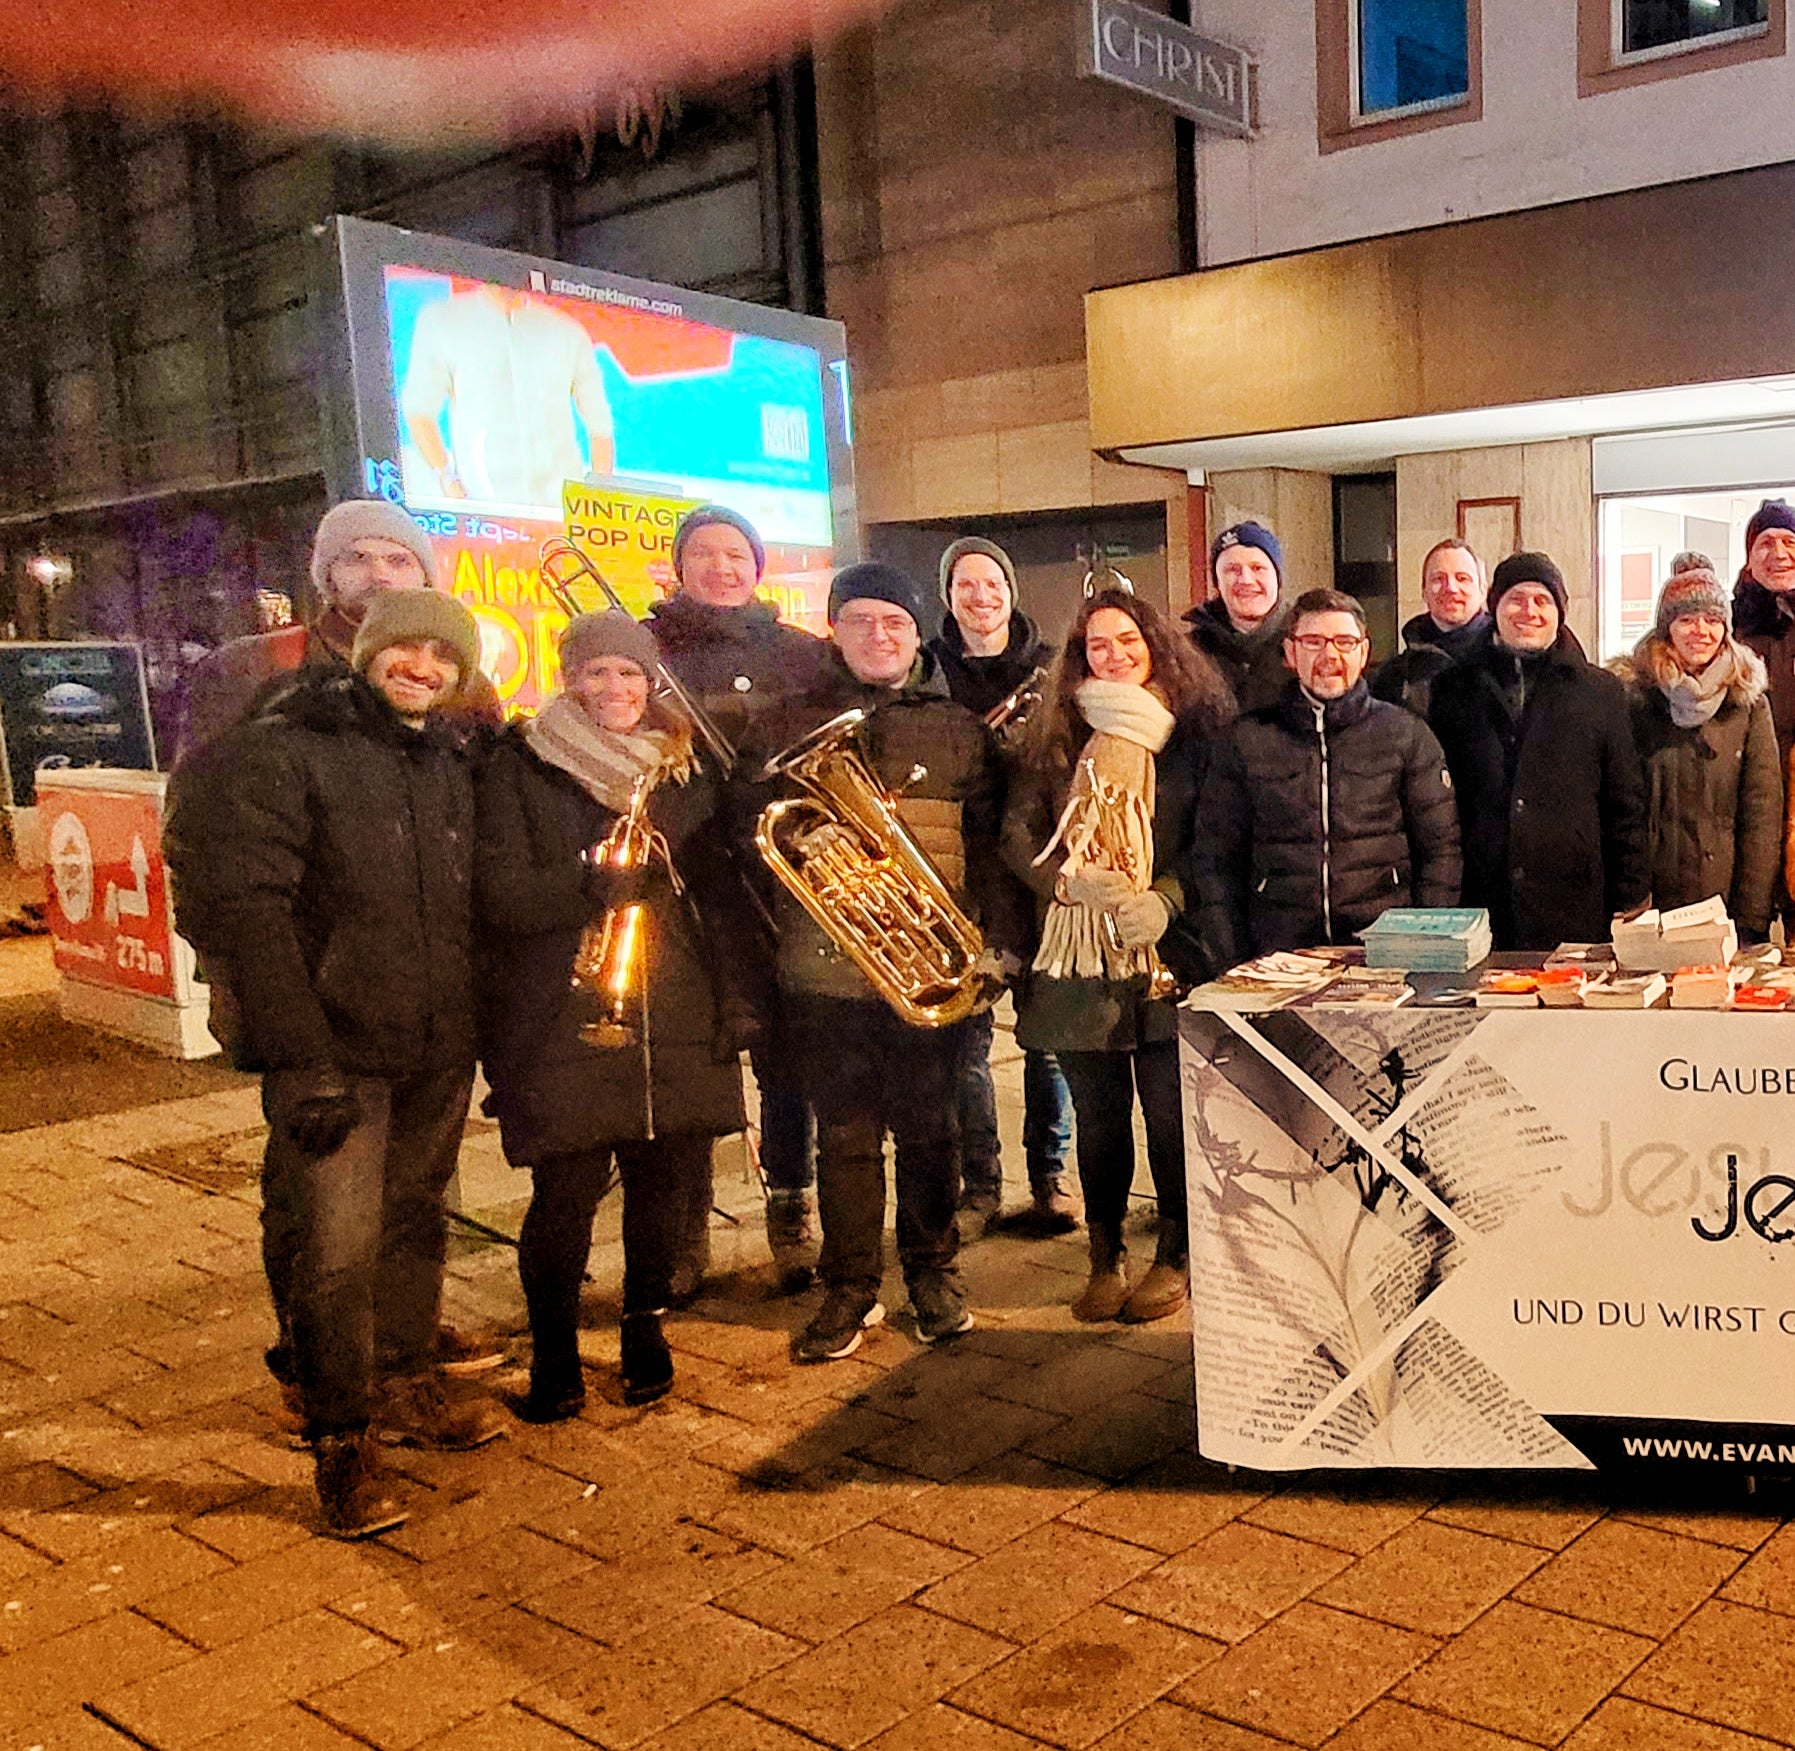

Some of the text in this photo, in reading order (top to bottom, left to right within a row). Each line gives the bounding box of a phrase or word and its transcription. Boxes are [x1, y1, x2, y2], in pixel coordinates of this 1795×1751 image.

[1102, 15, 1236, 106] CHRIST
[551, 278, 683, 317] stadtreklame.com
[569, 524, 629, 547] POP
[1513, 1299, 1584, 1327] UND
[1599, 1301, 1647, 1328] DU
[1658, 1302, 1767, 1333] WIRST
